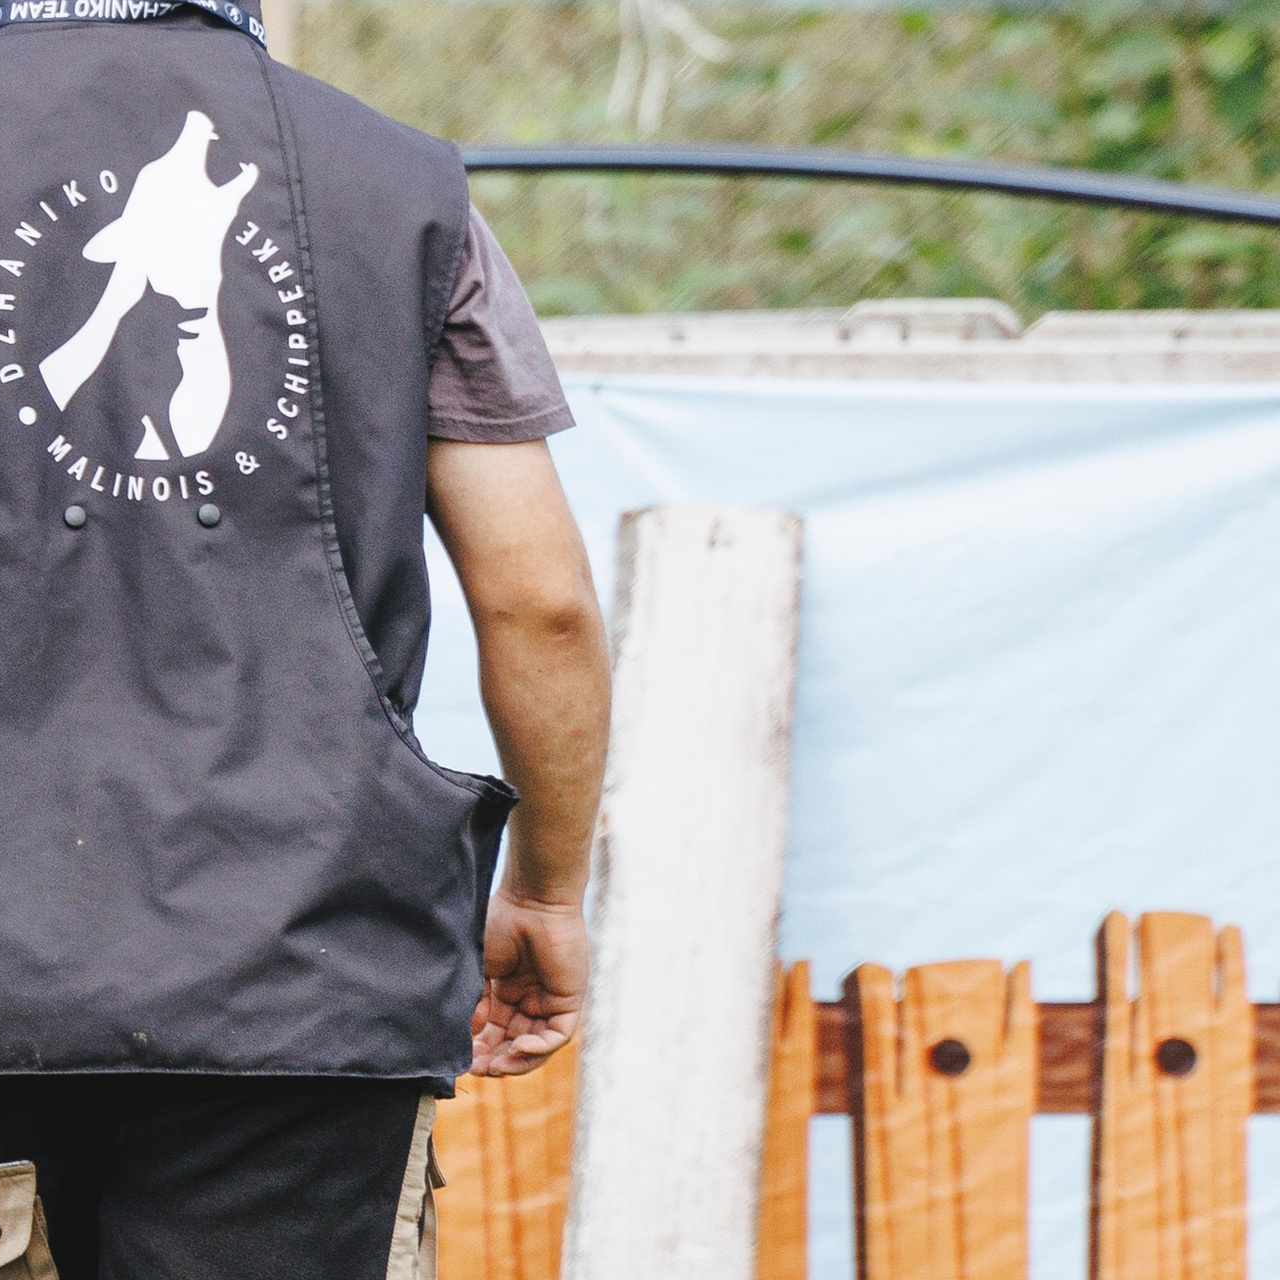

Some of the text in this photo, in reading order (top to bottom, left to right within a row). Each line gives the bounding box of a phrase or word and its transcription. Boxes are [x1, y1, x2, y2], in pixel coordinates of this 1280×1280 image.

[10, 0, 70, 20] TEAM
[47, 220, 310, 501] MALINOIS & SCHIPPERKE
